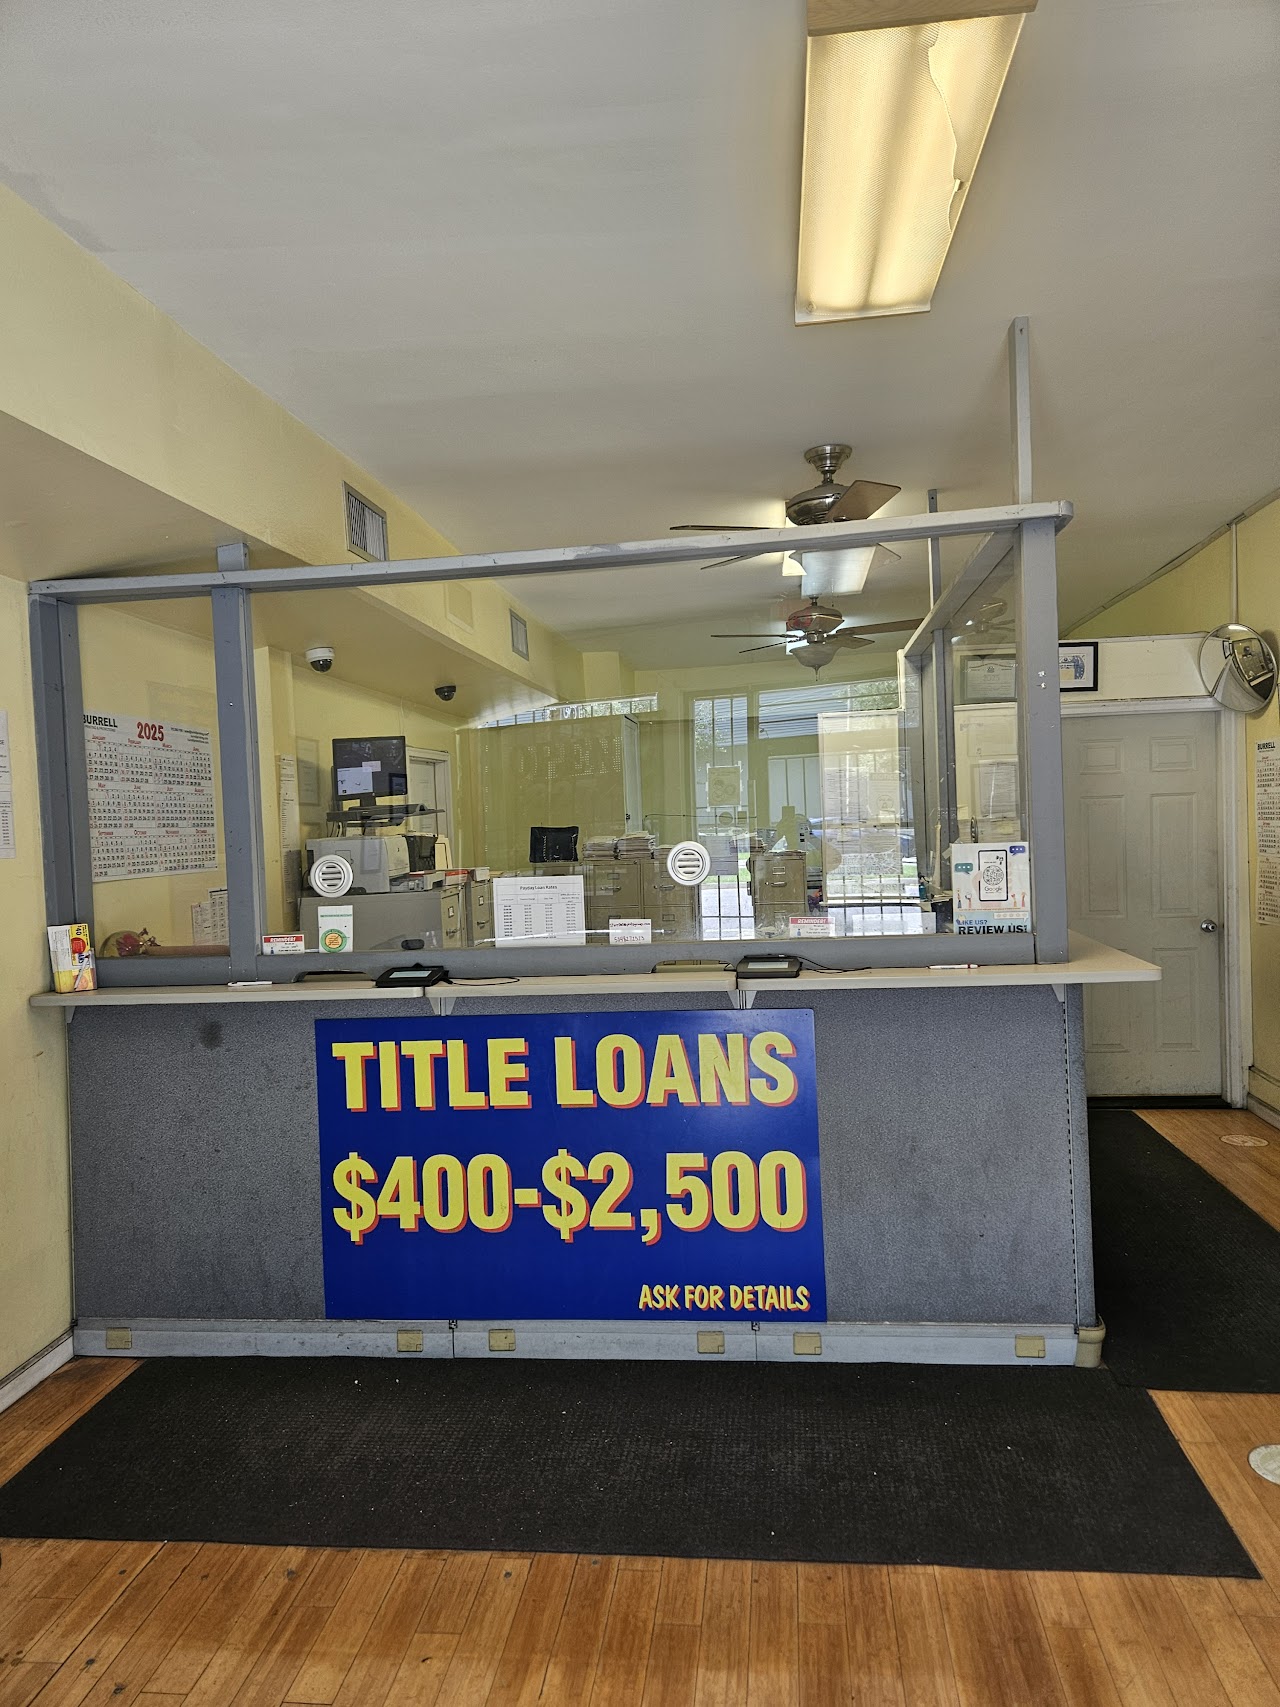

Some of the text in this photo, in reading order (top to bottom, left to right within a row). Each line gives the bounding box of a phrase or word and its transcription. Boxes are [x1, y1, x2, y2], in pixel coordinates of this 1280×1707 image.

[137, 722, 164, 741] 2025
[1258, 742, 1275, 750] BURRELL
[958, 926, 1004, 934] REVIEW
[332, 1031, 800, 1112] TITLE LOANS
[332, 1148, 808, 1245] $400-$2,500
[638, 1284, 811, 1312] ASK FOR DETAILS
